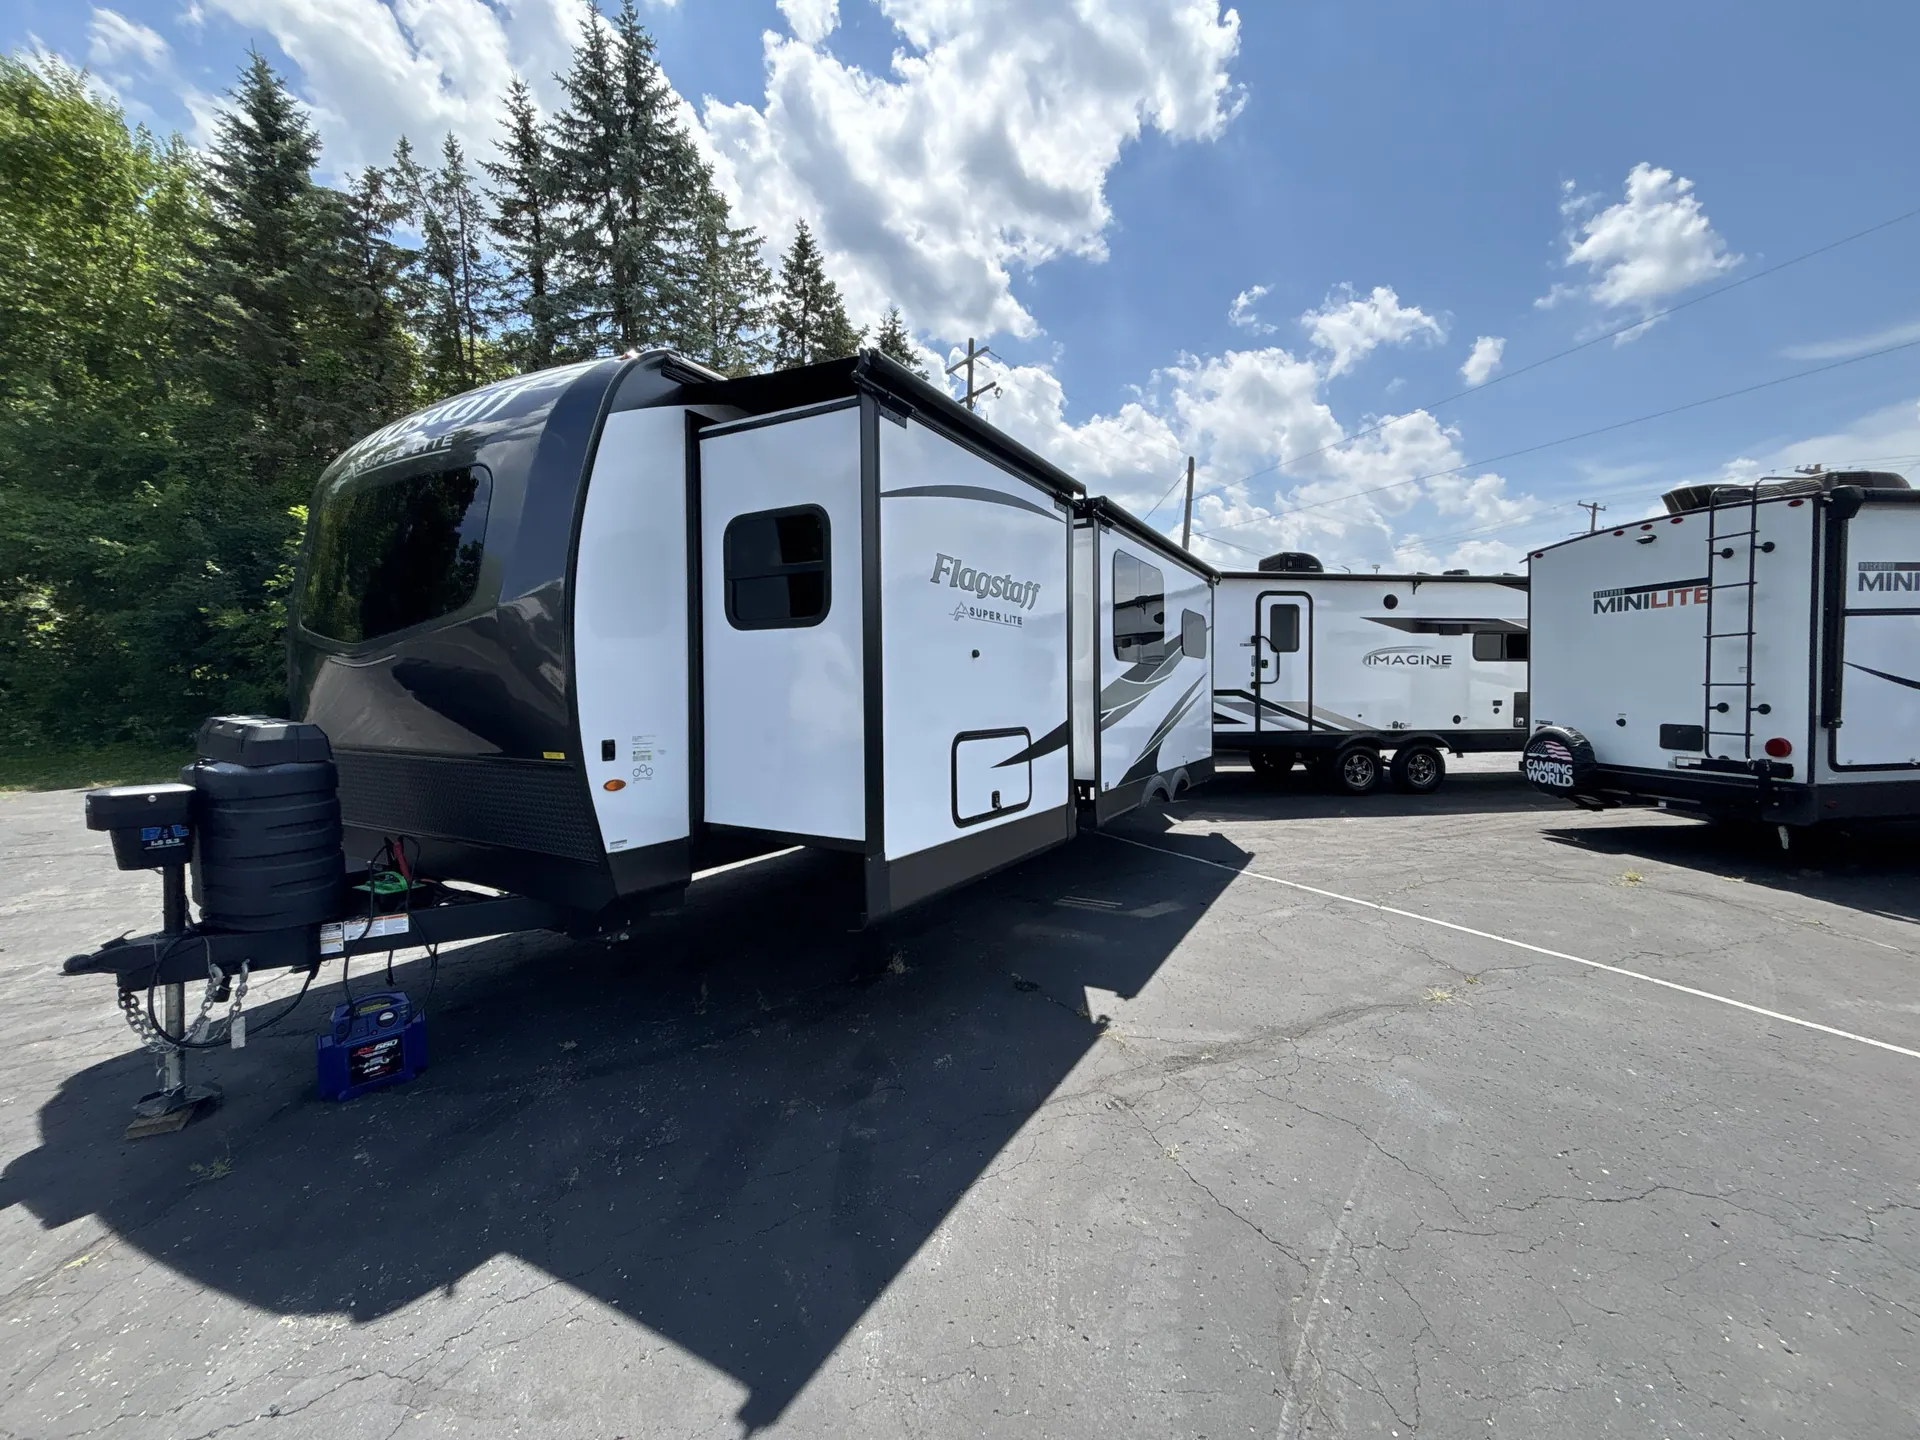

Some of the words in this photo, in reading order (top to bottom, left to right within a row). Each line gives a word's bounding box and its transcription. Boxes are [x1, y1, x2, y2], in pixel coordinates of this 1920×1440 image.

[357, 449, 404, 472] SUPER
[930, 552, 1041, 611] Flagstaff
[969, 606, 1001, 622] SUPER
[1004, 613, 1023, 626] LITE
[1367, 654, 1453, 666] IMAGINE
[1526, 758, 1573, 776] CAMPING
[1526, 768, 1574, 788] WORLD
